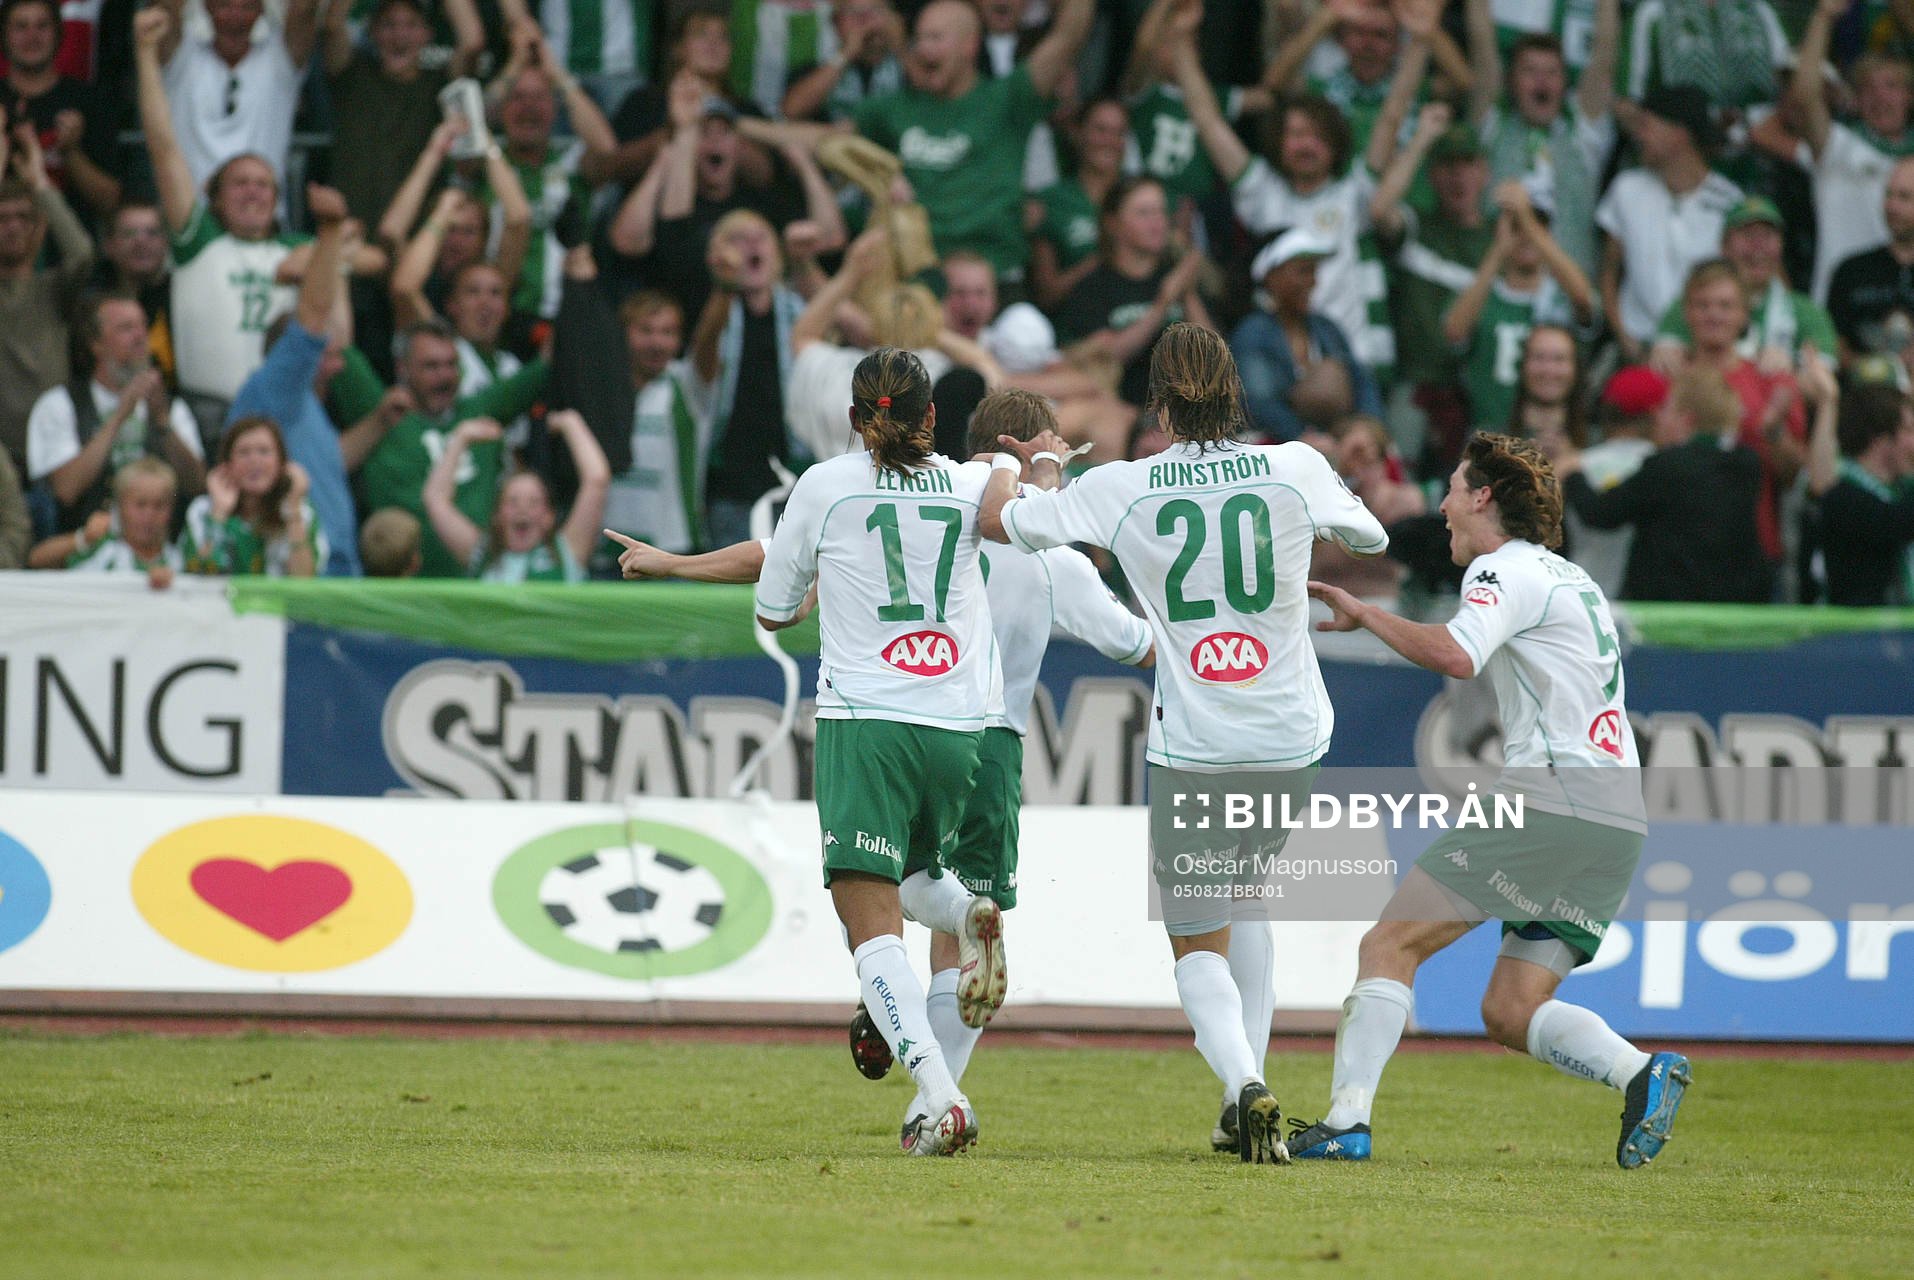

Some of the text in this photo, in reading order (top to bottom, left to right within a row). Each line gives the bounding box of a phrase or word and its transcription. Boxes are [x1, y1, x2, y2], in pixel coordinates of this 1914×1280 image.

[875, 468, 953, 494] ZENGIN
[1149, 452, 1271, 489] RUNSTRÖM
[866, 503, 962, 623] 17
[1156, 493, 1276, 622] 20
[890, 635, 953, 668] AXA
[1197, 637, 1263, 674] AXA
[1579, 591, 1621, 702] 5
[382, 659, 1151, 805] STADM
[1551, 896, 1607, 939] Folksa
[872, 975, 902, 1032] PEUGEOT
